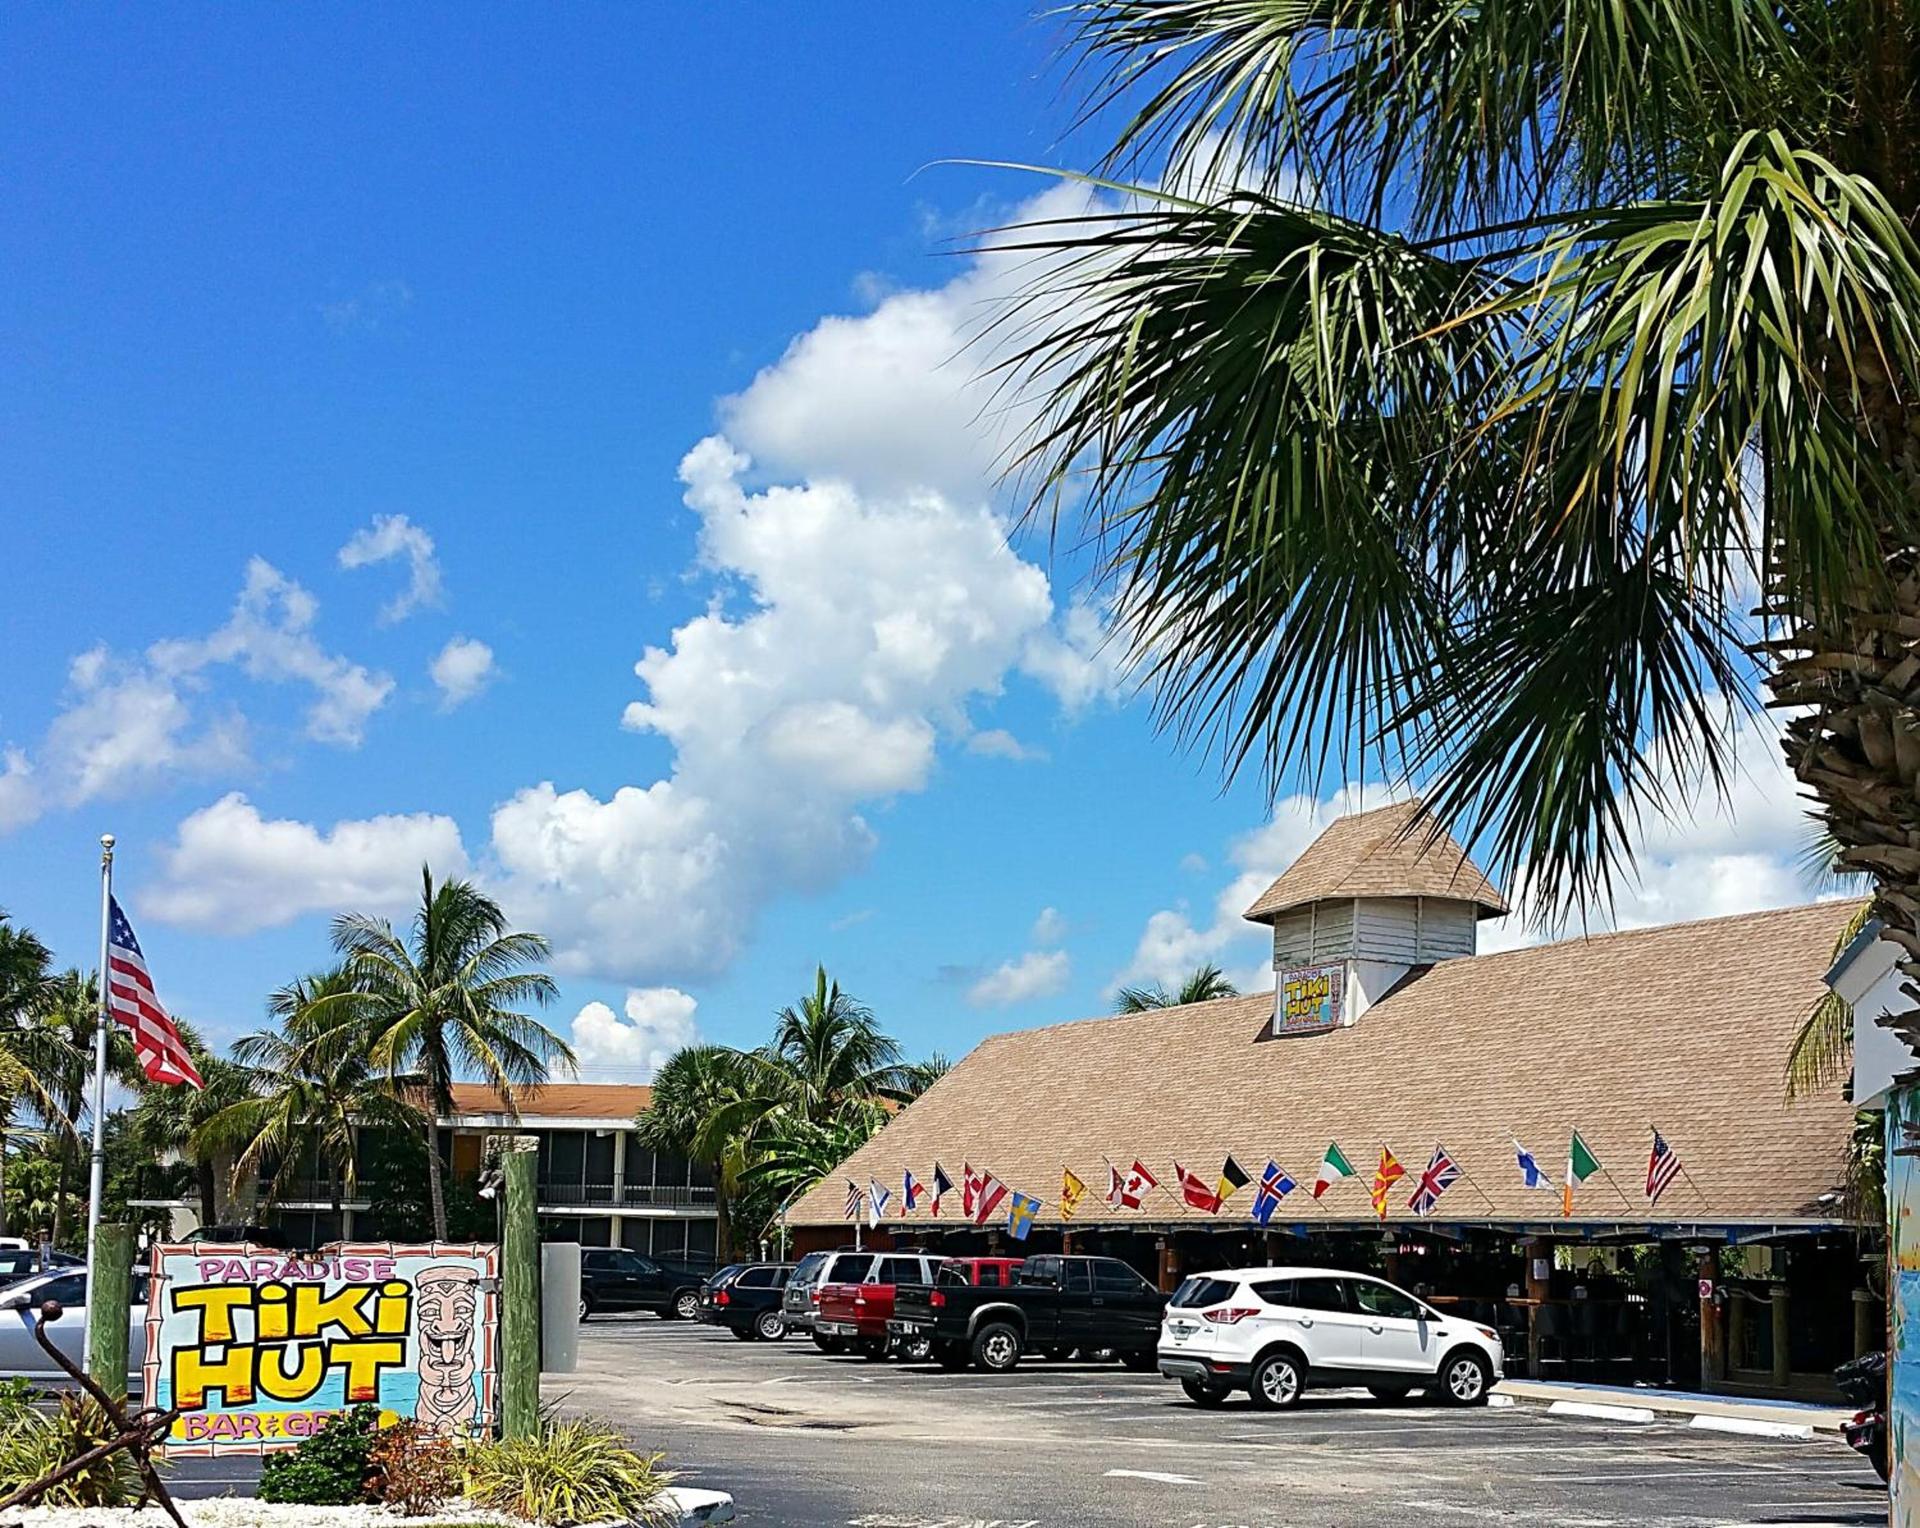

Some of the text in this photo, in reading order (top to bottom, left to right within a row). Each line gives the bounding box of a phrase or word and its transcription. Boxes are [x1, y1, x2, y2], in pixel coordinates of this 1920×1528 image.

[1286, 997, 1323, 1019] HUT
[171, 1339, 406, 1409] HUT
[183, 1413, 264, 1441] BAR
